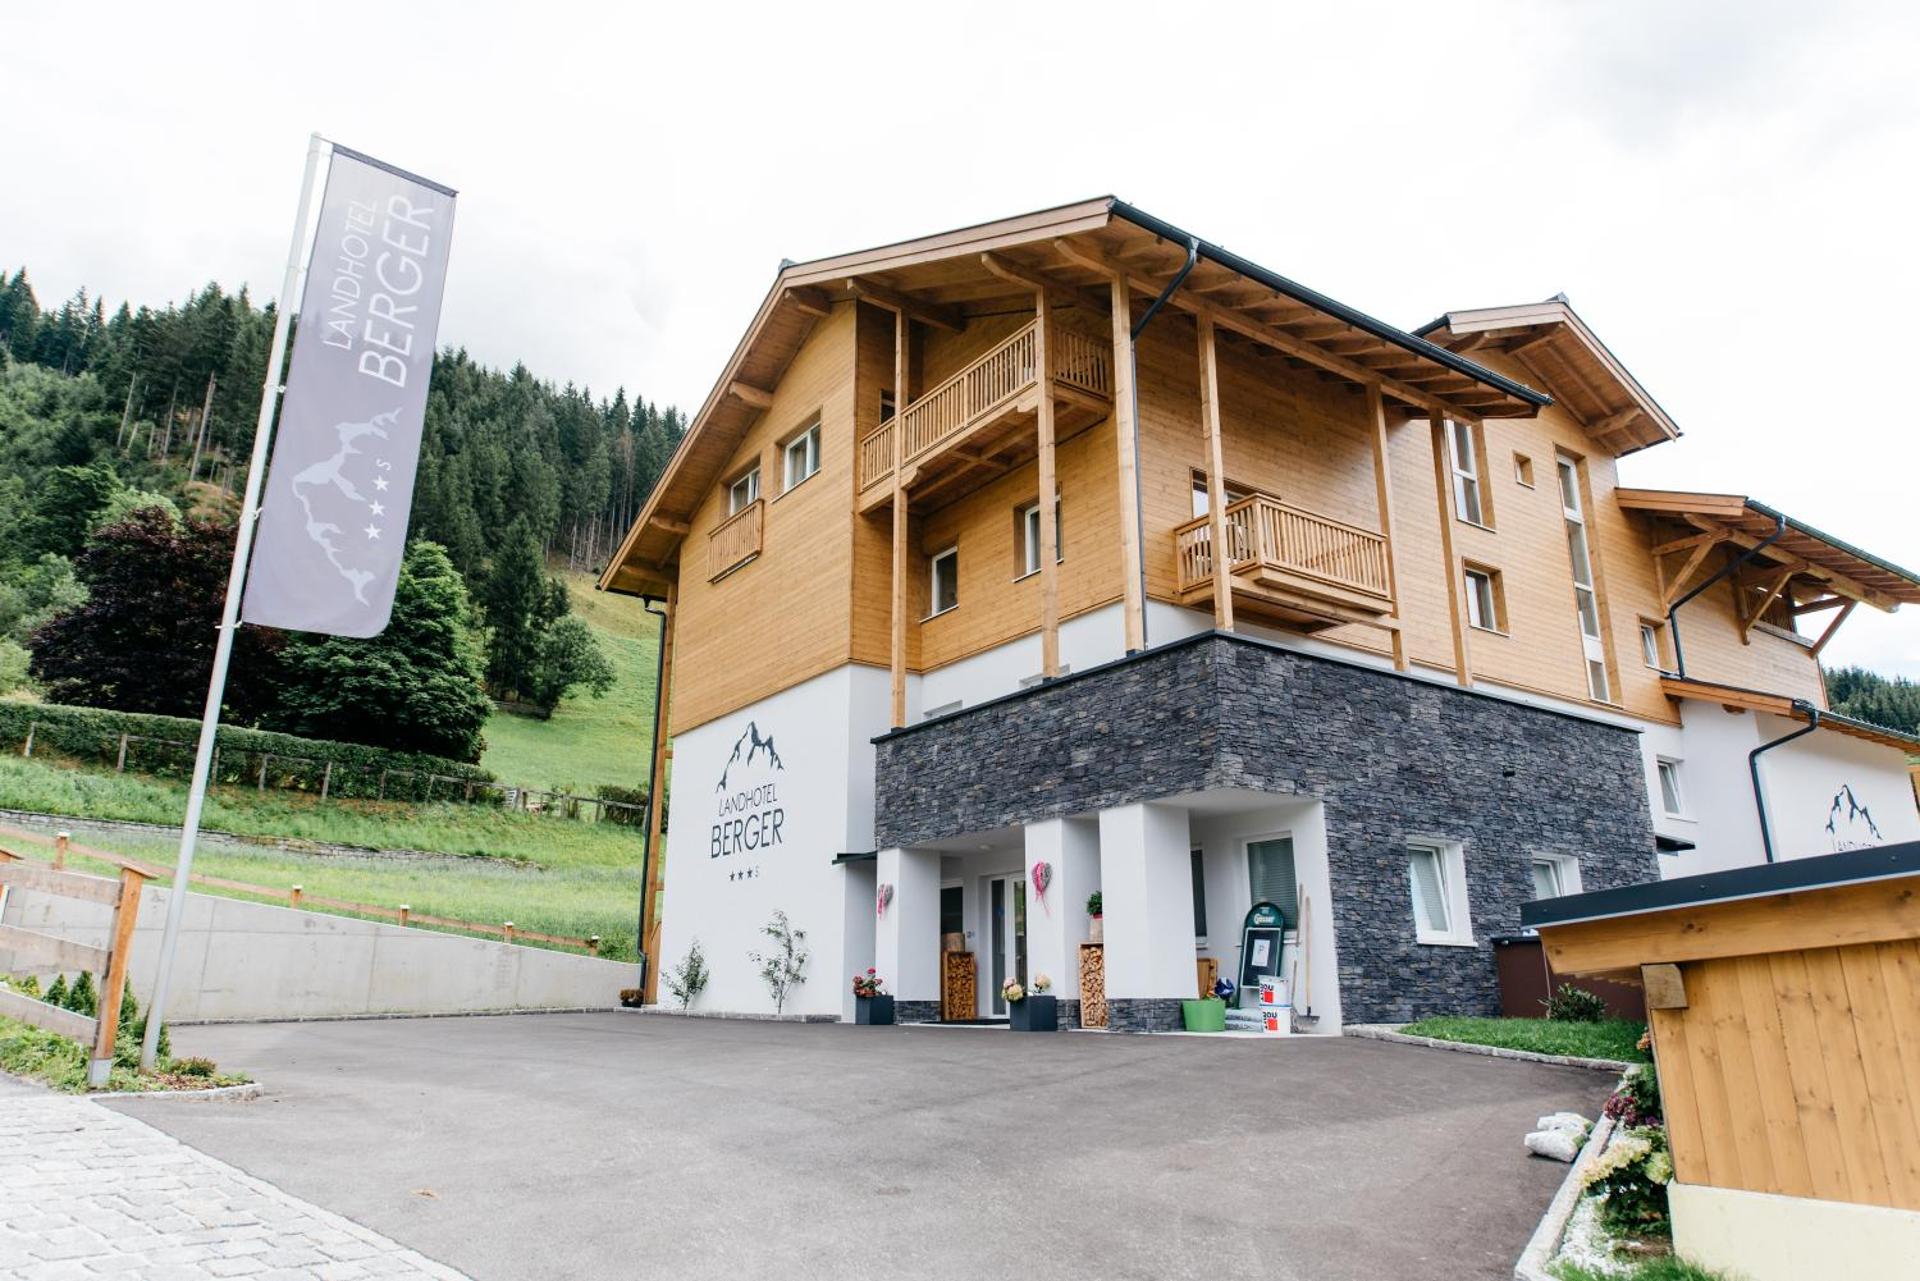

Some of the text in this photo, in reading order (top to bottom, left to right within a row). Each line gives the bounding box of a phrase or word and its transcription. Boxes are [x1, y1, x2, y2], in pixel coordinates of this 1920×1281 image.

[323, 200, 377, 350] LANDHOTEL
[358, 194, 434, 388] BERGER
[710, 808, 784, 858] BERGER
[718, 783, 778, 817] LANDHOTEL
